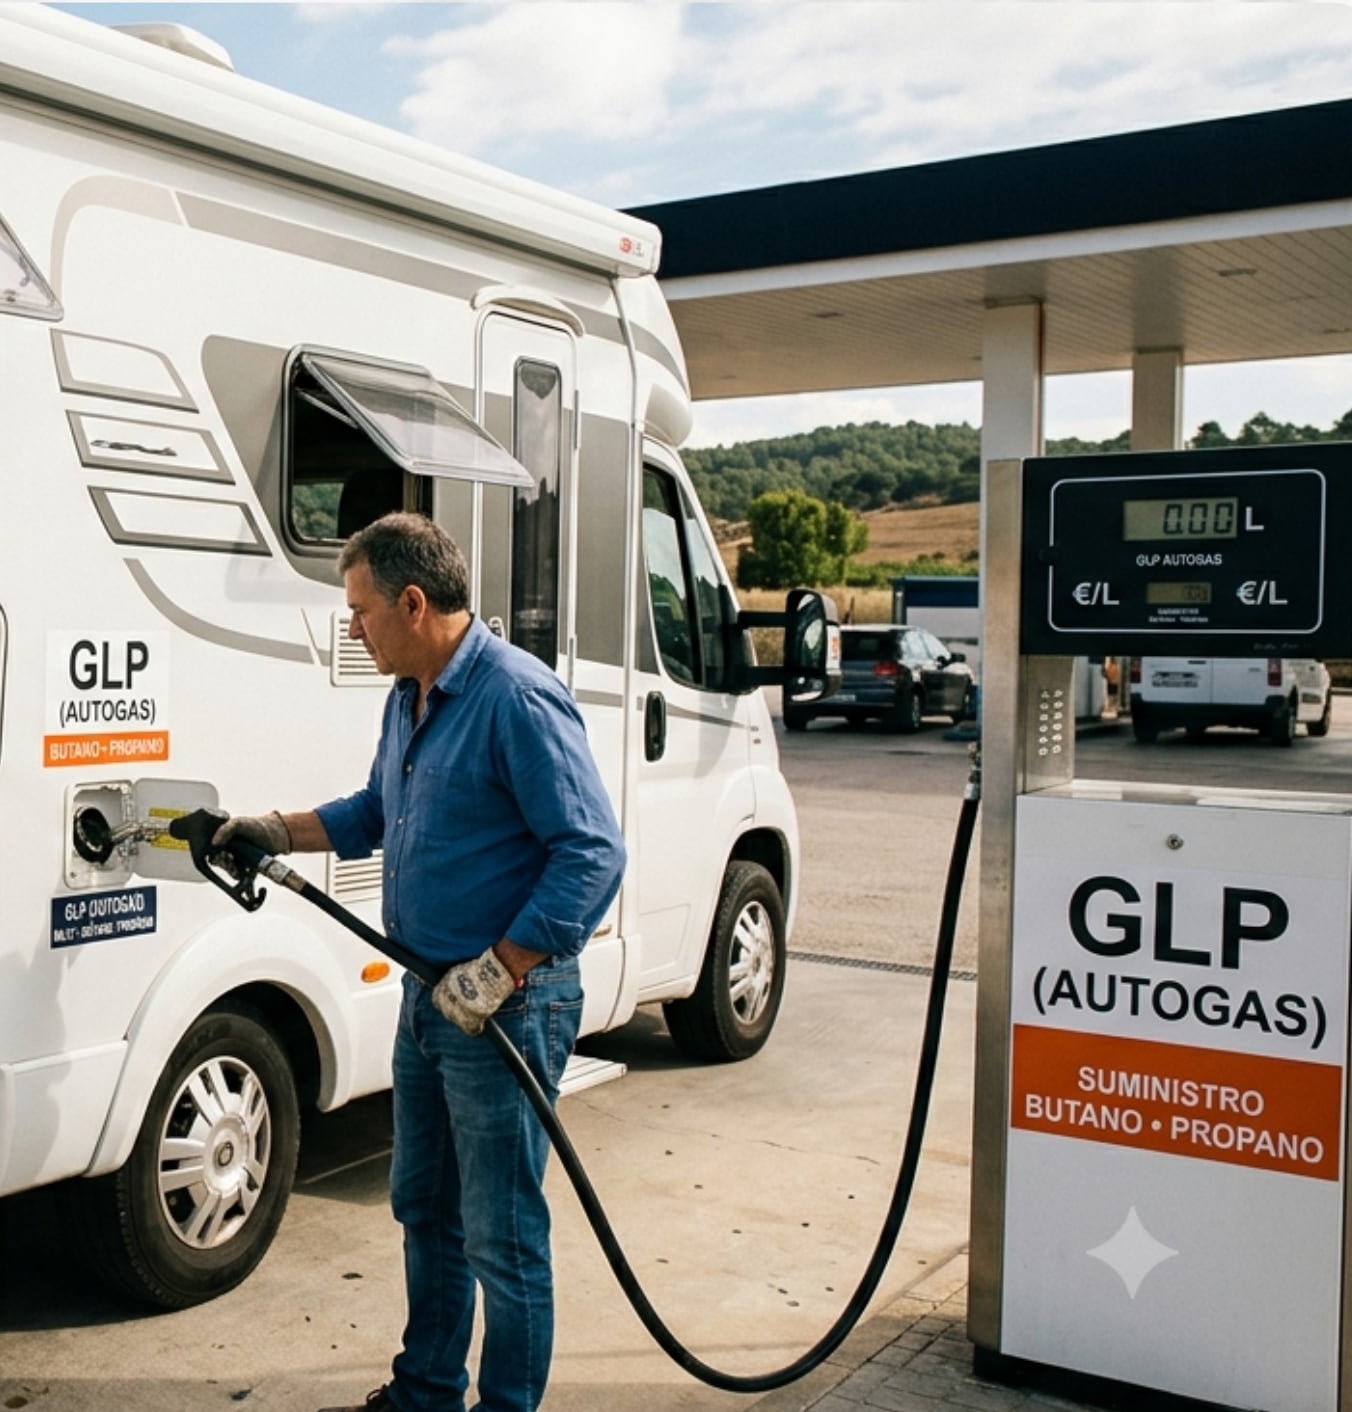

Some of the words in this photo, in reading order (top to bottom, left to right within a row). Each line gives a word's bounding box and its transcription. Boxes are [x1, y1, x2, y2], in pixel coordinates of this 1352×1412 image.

[1245, 506, 1264, 530] L
[69, 639, 149, 691] GLP
[59, 699, 156, 728] (AUTOGAS)
[1068, 875, 1290, 970] GLP
[1033, 966, 1327, 1050] (AUTOGAS)
[1077, 1065, 1265, 1117] SUMINISTRO
[1025, 1093, 1143, 1135] BUTANO
[1170, 1115, 1325, 1164] PROPANO
